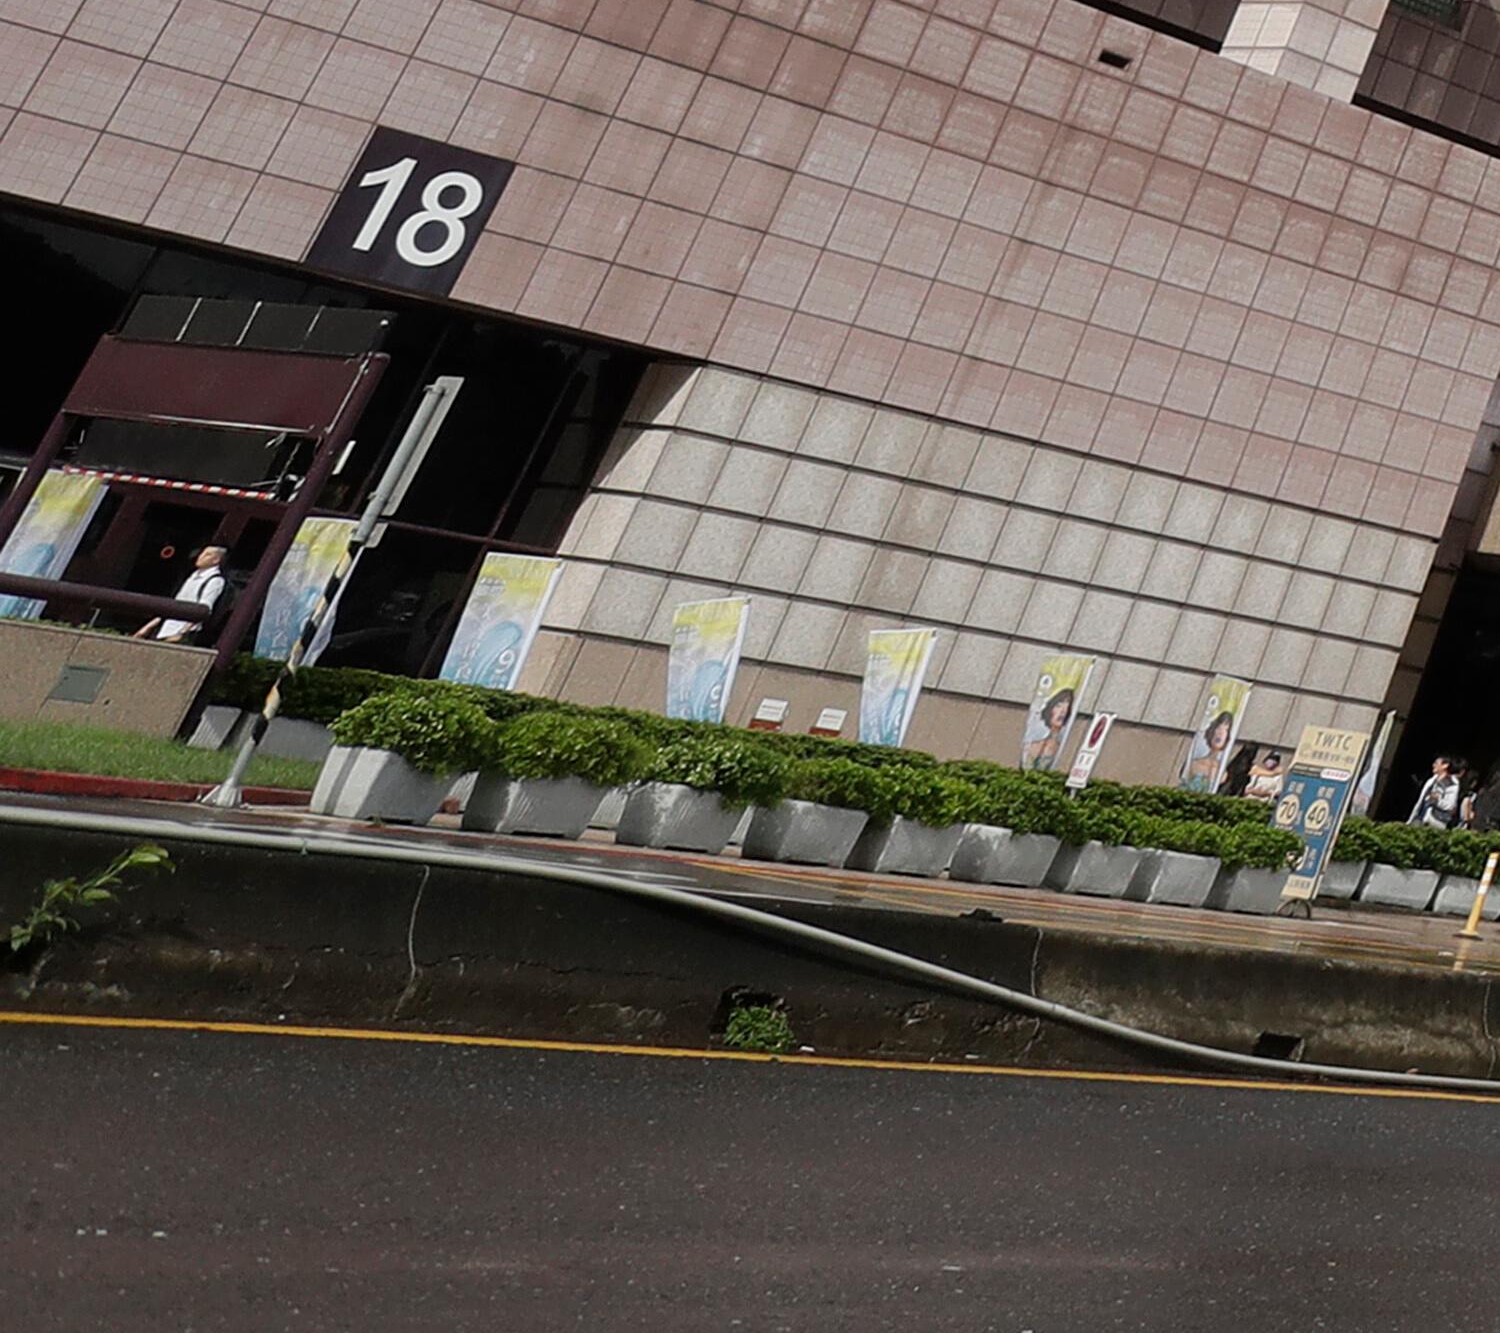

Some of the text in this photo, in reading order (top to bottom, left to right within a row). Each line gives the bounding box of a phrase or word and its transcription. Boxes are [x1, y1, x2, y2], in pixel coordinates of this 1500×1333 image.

[352, 156, 484, 267] 18
[1313, 730, 1354, 751] TWTC
[1279, 800, 1297, 819] 70
[1307, 807, 1327, 826] 40
